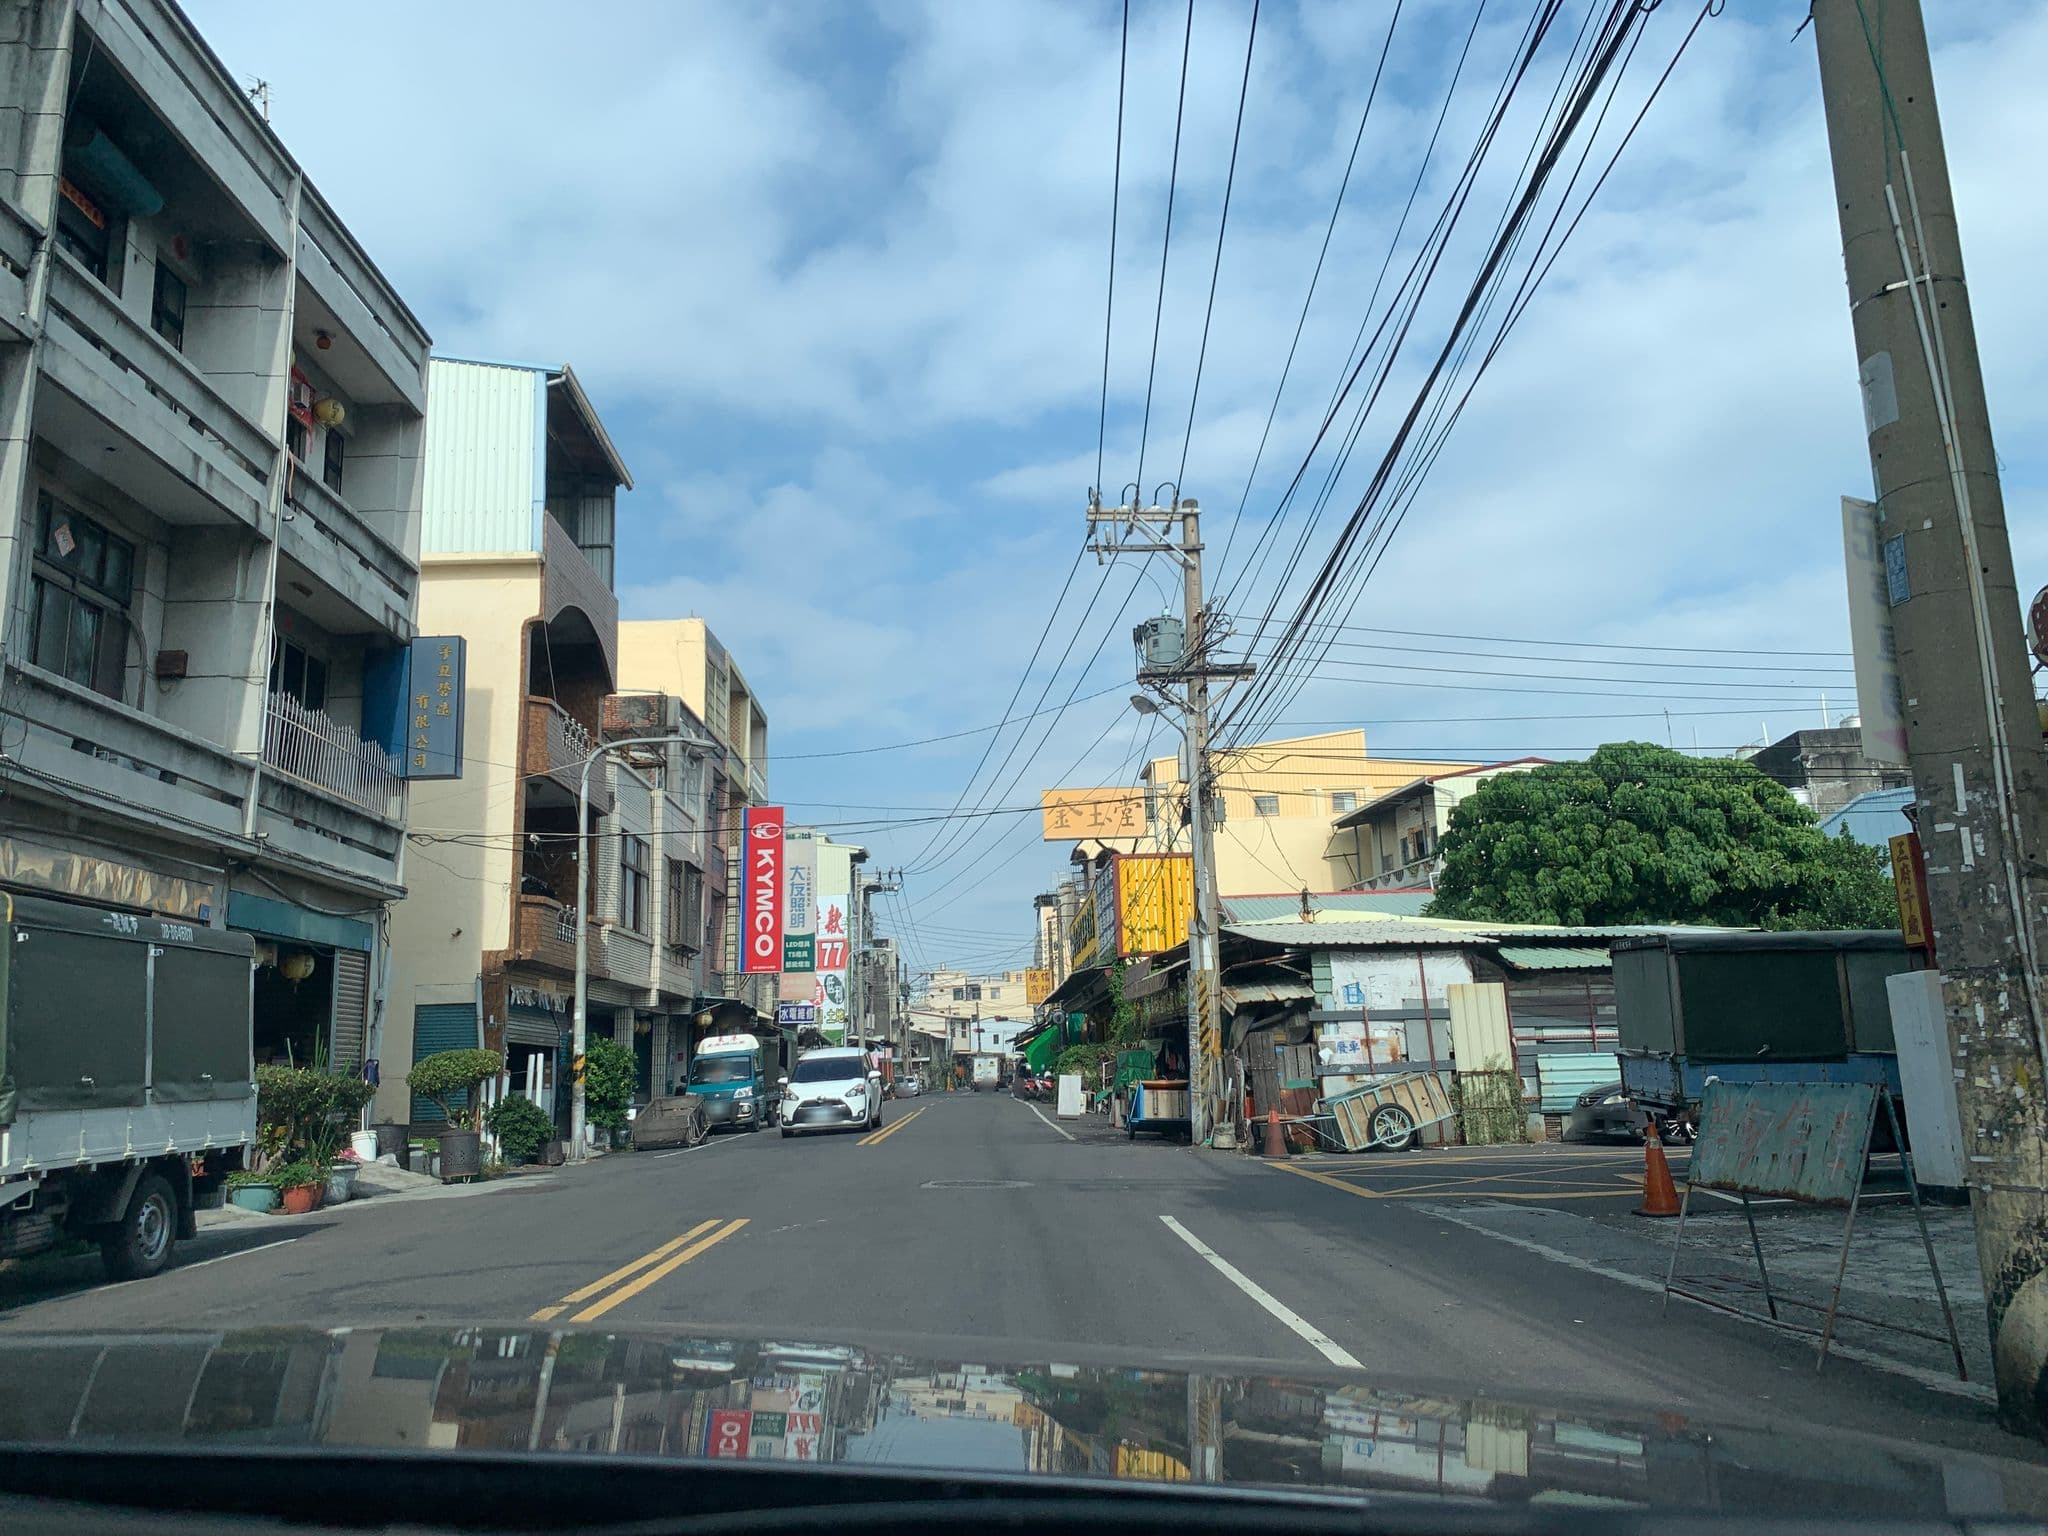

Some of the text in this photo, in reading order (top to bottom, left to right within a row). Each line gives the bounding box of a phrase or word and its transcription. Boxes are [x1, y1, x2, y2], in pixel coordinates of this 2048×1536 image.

[414, 692, 431, 768] 有限公司
[1047, 794, 1143, 829] 金玉堂
[754, 848, 775, 957] KYMCO
[788, 865, 806, 928] 大友照明
